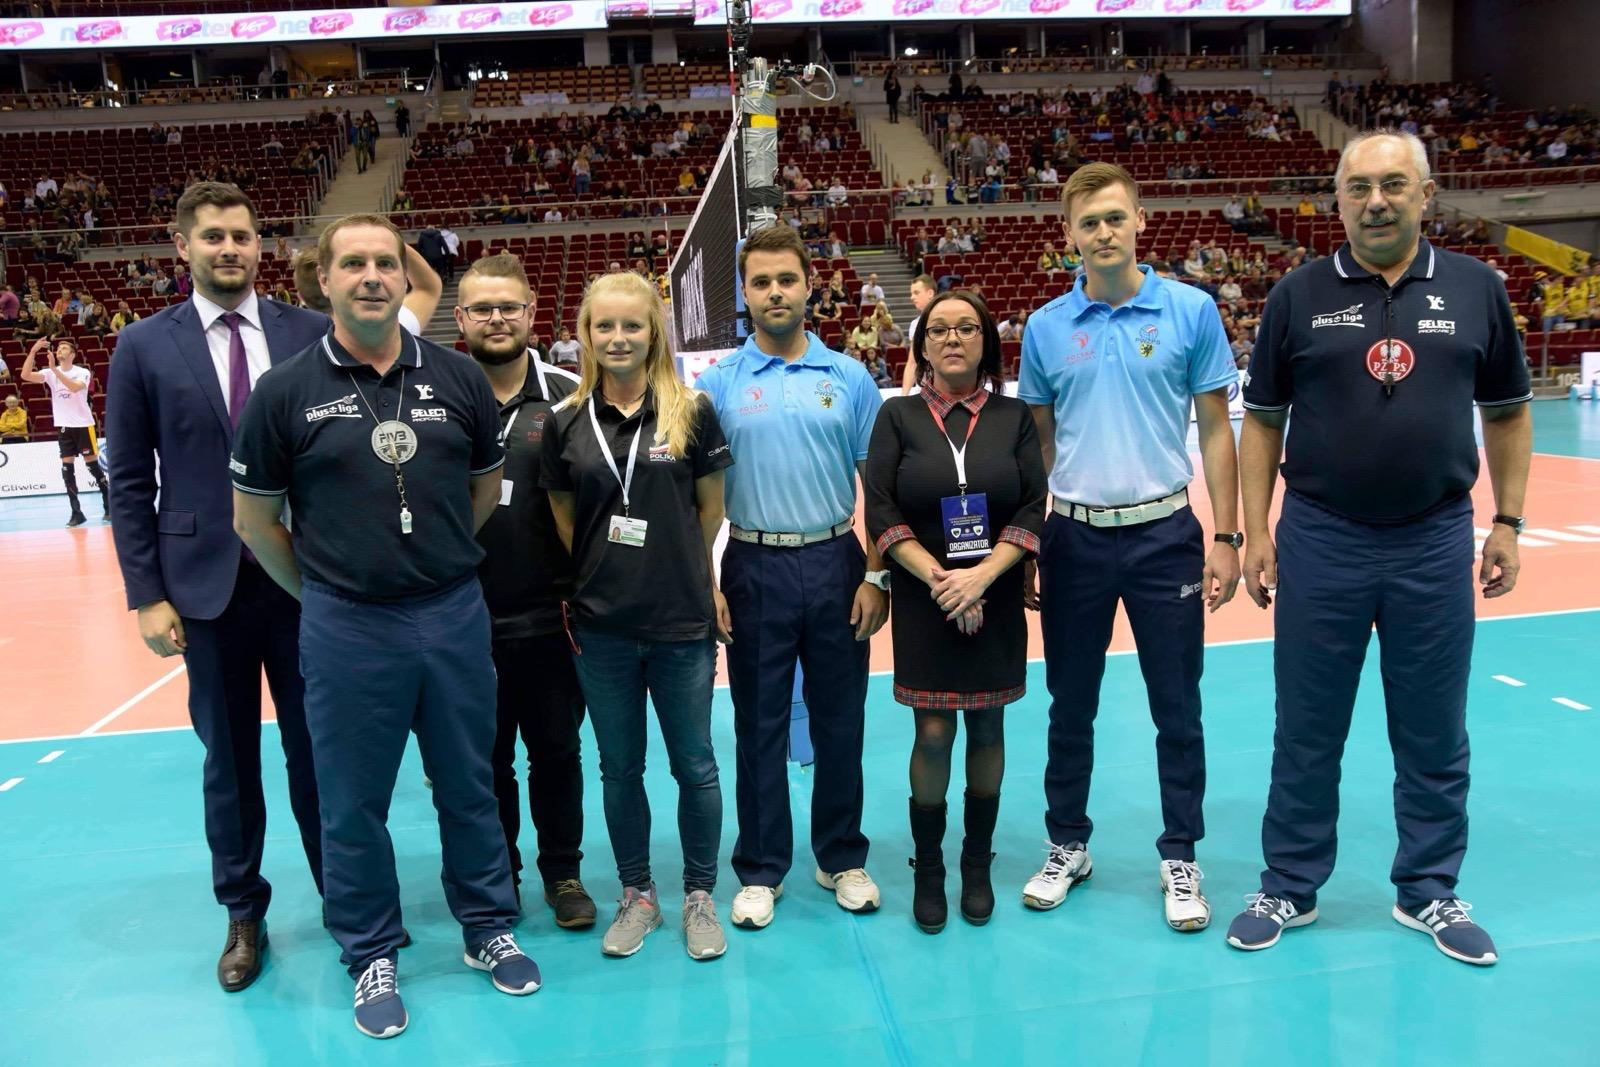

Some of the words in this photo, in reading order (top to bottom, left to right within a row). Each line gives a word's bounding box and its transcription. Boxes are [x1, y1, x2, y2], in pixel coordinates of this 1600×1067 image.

[1418, 320, 1455, 329] SELECT
[410, 408, 447, 419] SELECT
[379, 430, 407, 443] FIVB
[1, 483, 47, 492] Gliwice
[949, 539, 989, 552] ORGANIZATOR
